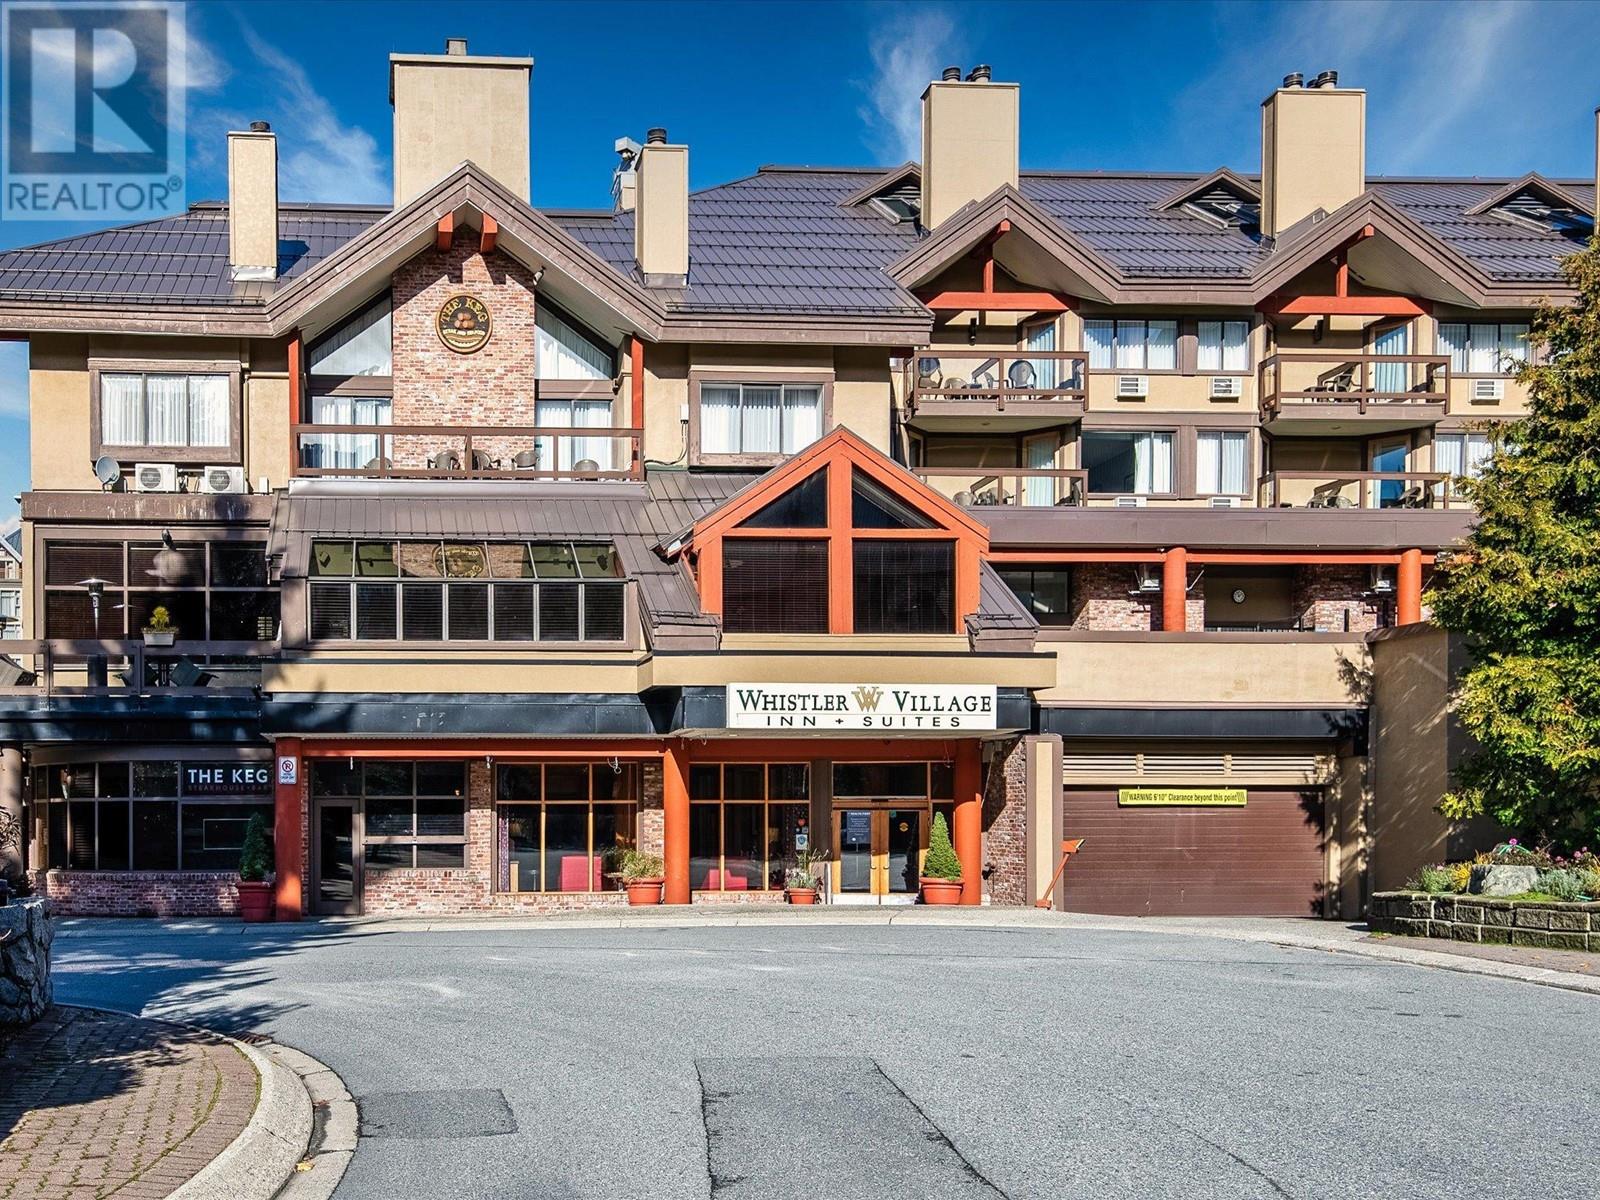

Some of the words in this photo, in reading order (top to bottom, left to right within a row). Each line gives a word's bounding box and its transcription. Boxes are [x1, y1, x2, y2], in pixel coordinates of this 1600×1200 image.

[465, 297, 489, 322] KEG
[766, 715, 817, 727] INN
[862, 716, 961, 728] SUITES
[187, 768, 224, 784] THE
[232, 768, 268, 784] KEG
[1129, 793, 1153, 801] WARNING
[1168, 793, 1194, 801] Clearance
[1194, 793, 1213, 803] beyond
[1213, 793, 1223, 801] this
[1224, 793, 1238, 803] point
